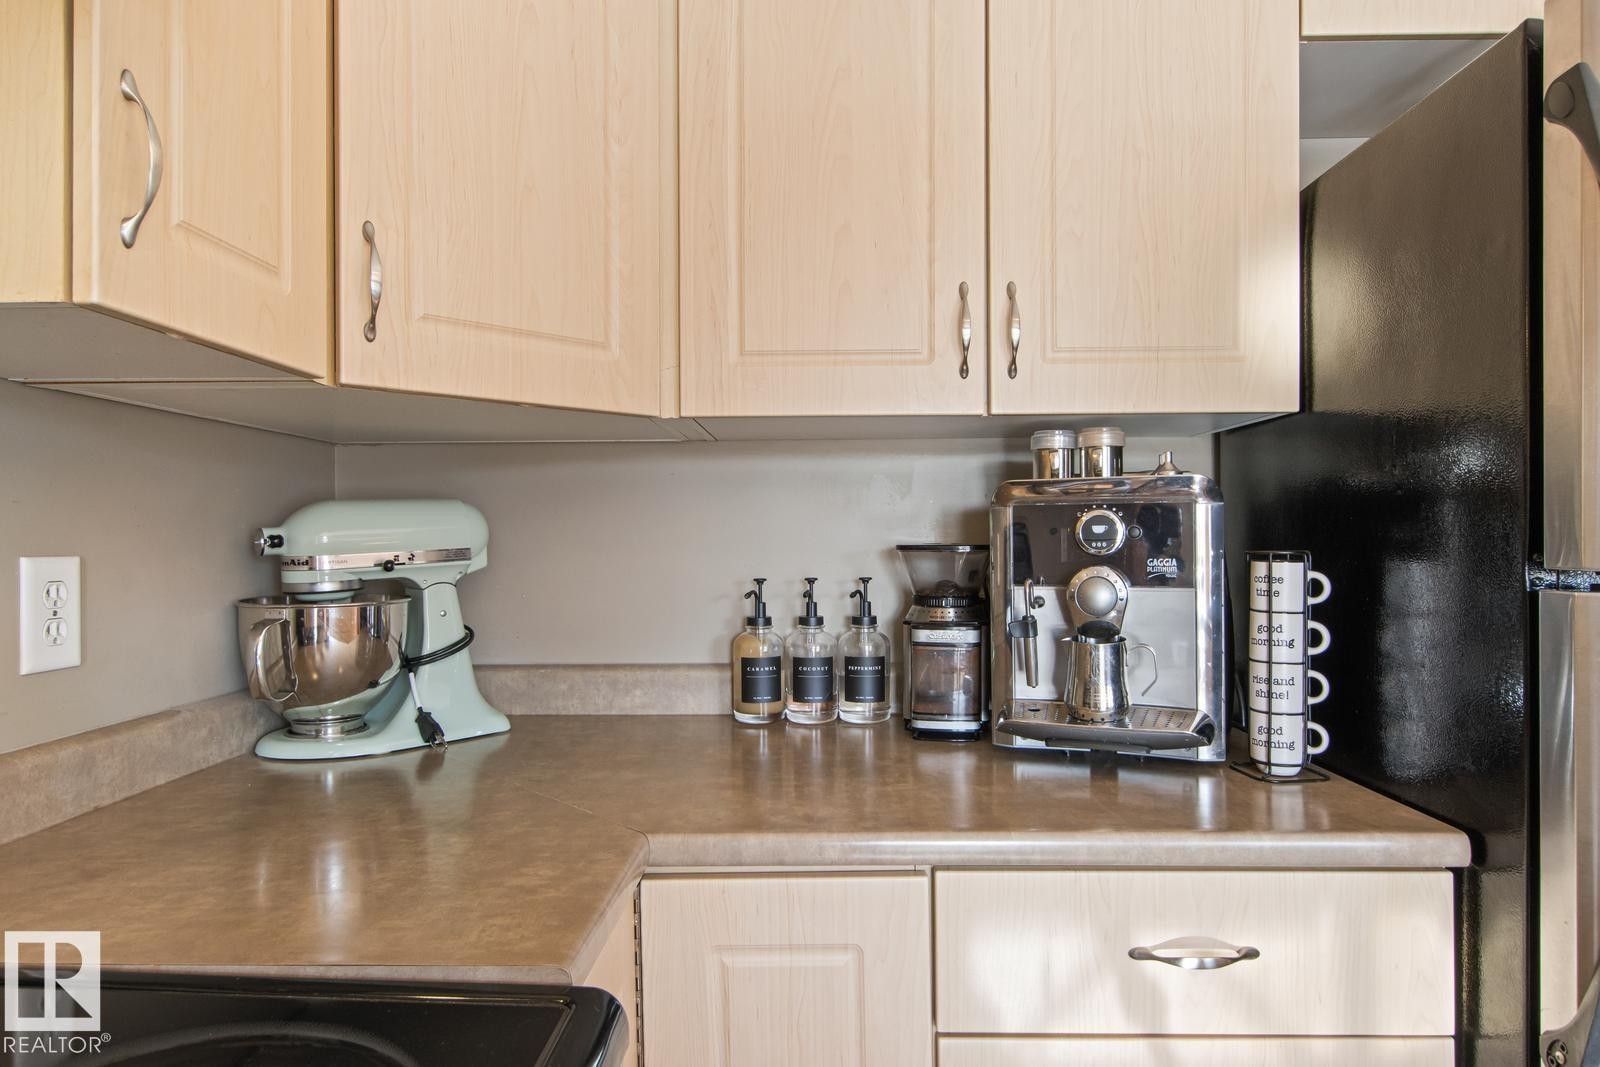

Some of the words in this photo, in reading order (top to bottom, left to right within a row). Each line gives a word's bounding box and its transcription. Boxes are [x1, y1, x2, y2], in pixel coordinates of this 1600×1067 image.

[1147, 558, 1177, 566] GAGGIA
[1251, 637, 1295, 649] morning
[1252, 675, 1270, 685] rise
[1273, 676, 1295, 686] and
[1252, 737, 1295, 751] morning
